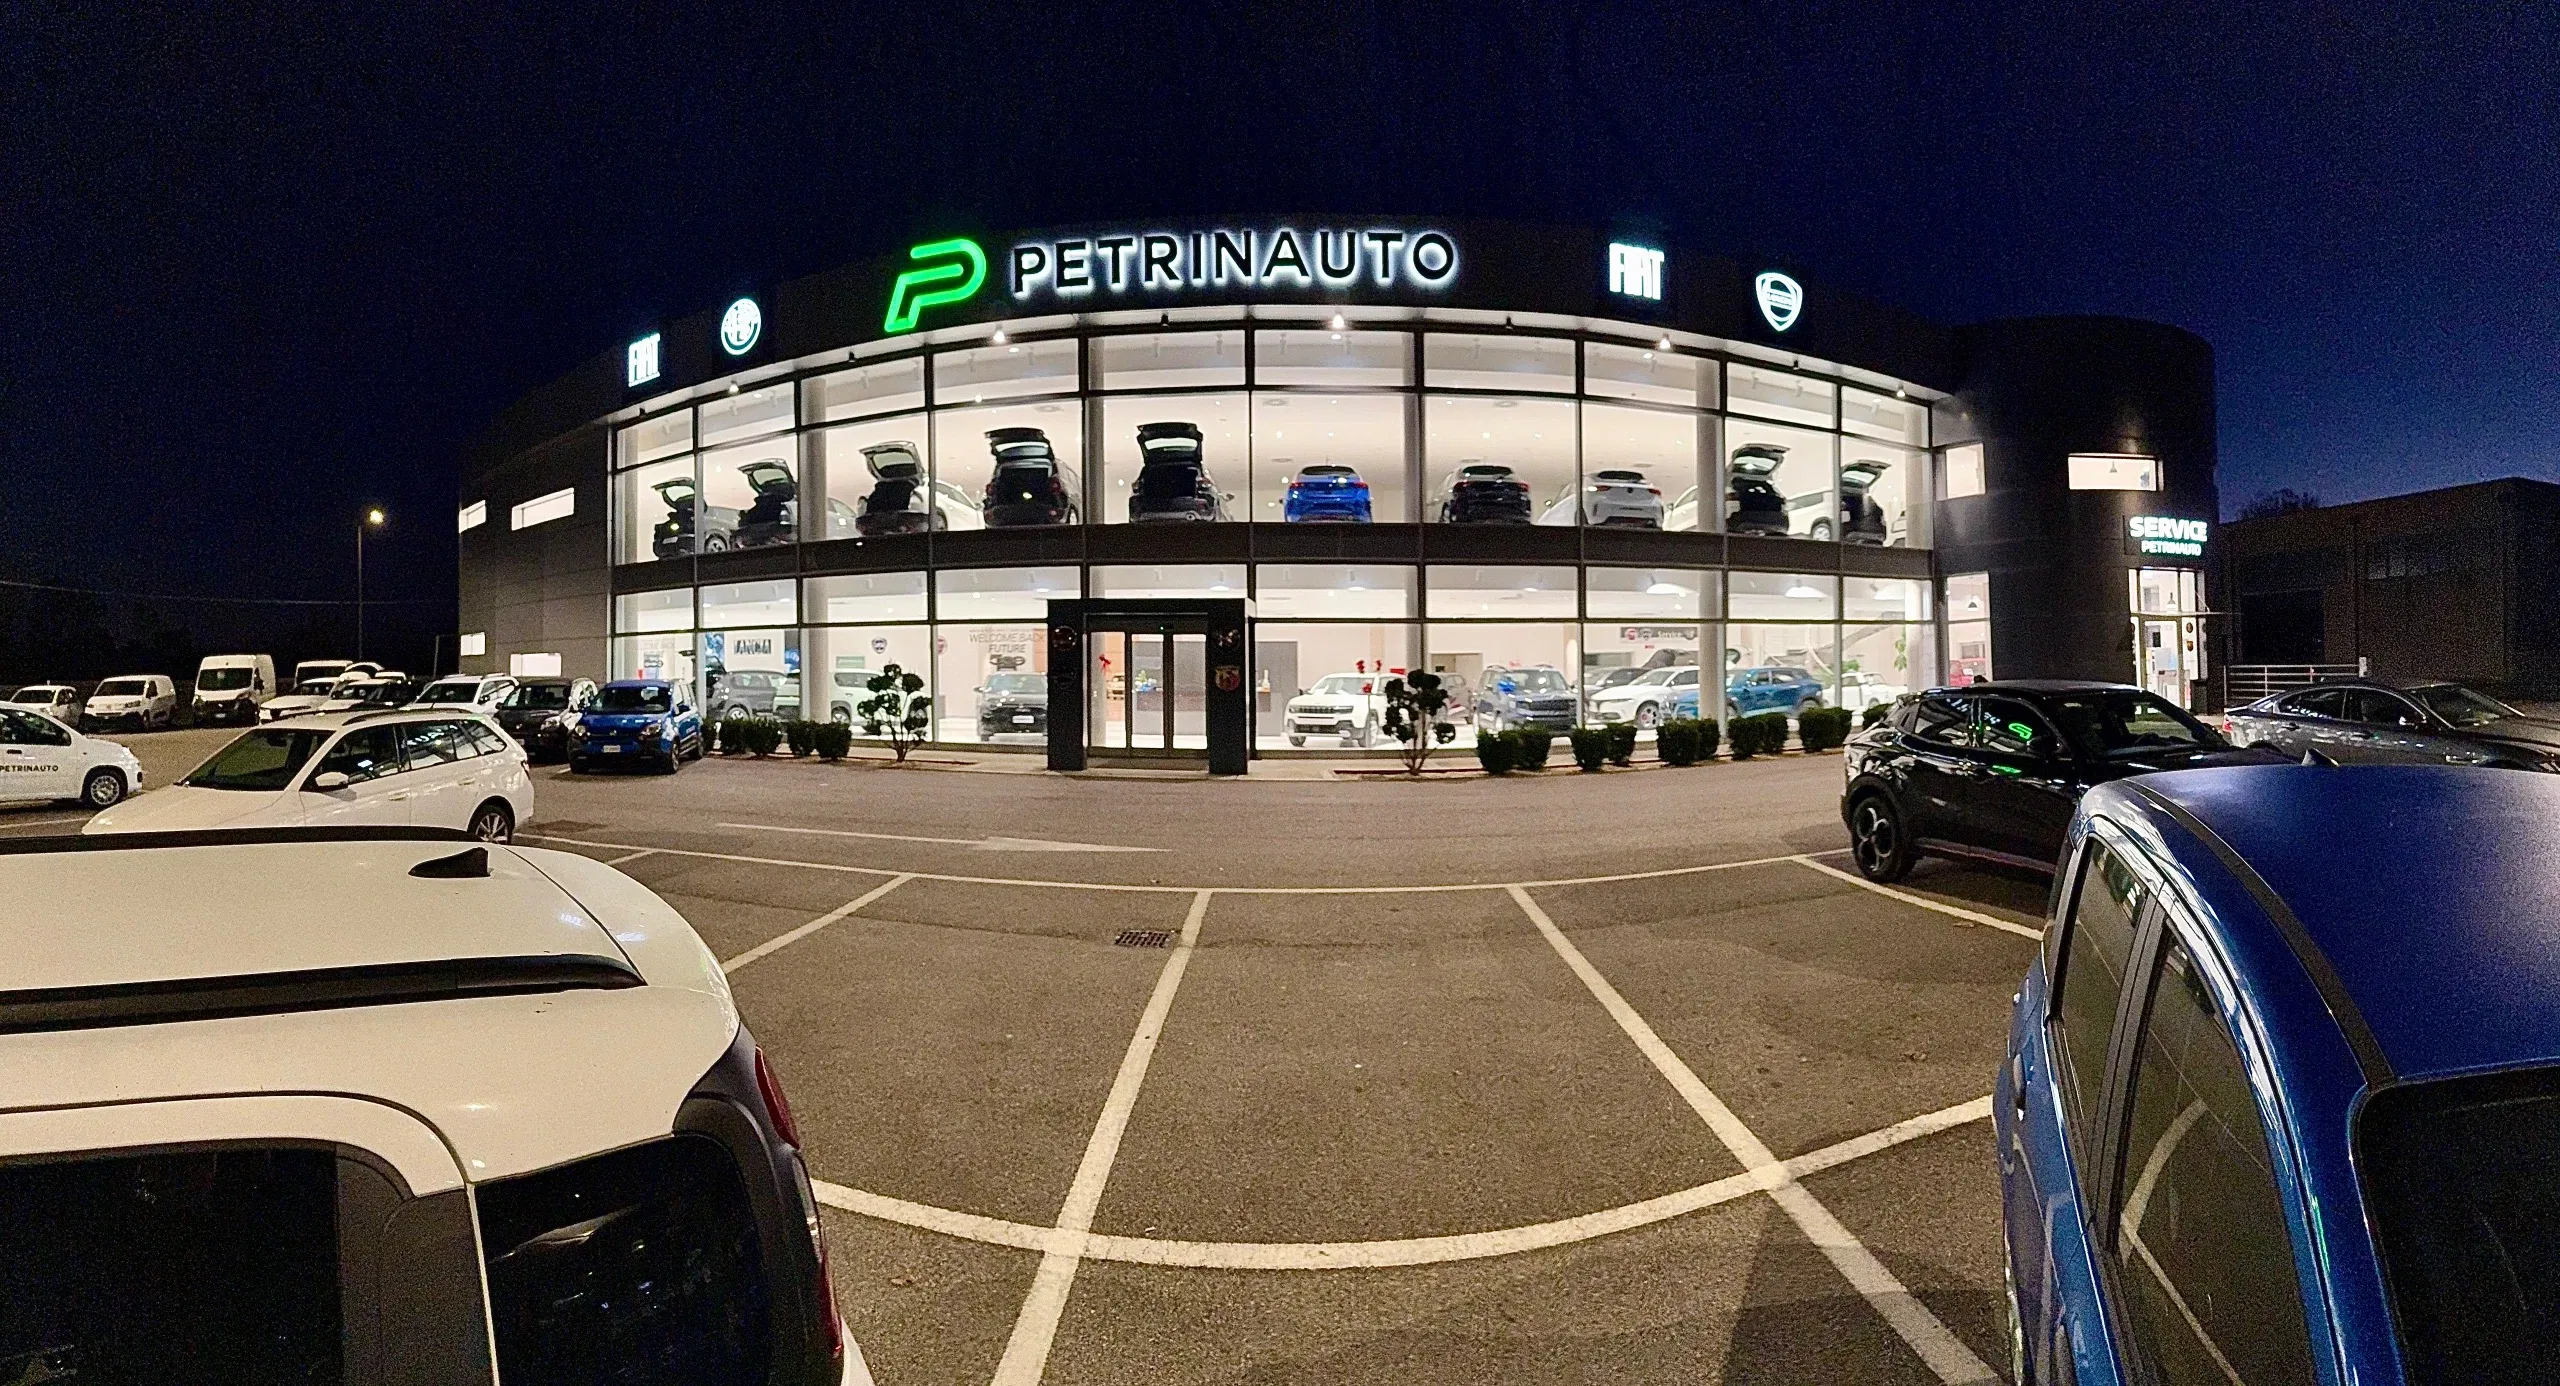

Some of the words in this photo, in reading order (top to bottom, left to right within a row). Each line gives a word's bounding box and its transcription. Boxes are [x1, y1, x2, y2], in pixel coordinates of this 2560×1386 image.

[1012, 229, 1455, 294] PETRINAUTO
[1608, 242, 1665, 300] FIAT
[628, 332, 661, 388] FIAT
[2129, 516, 2208, 542] SERVICE
[2141, 540, 2202, 556] PETRINAUTO
[968, 632, 1018, 643] WELCOME
[988, 643, 1027, 654] FUTURE
